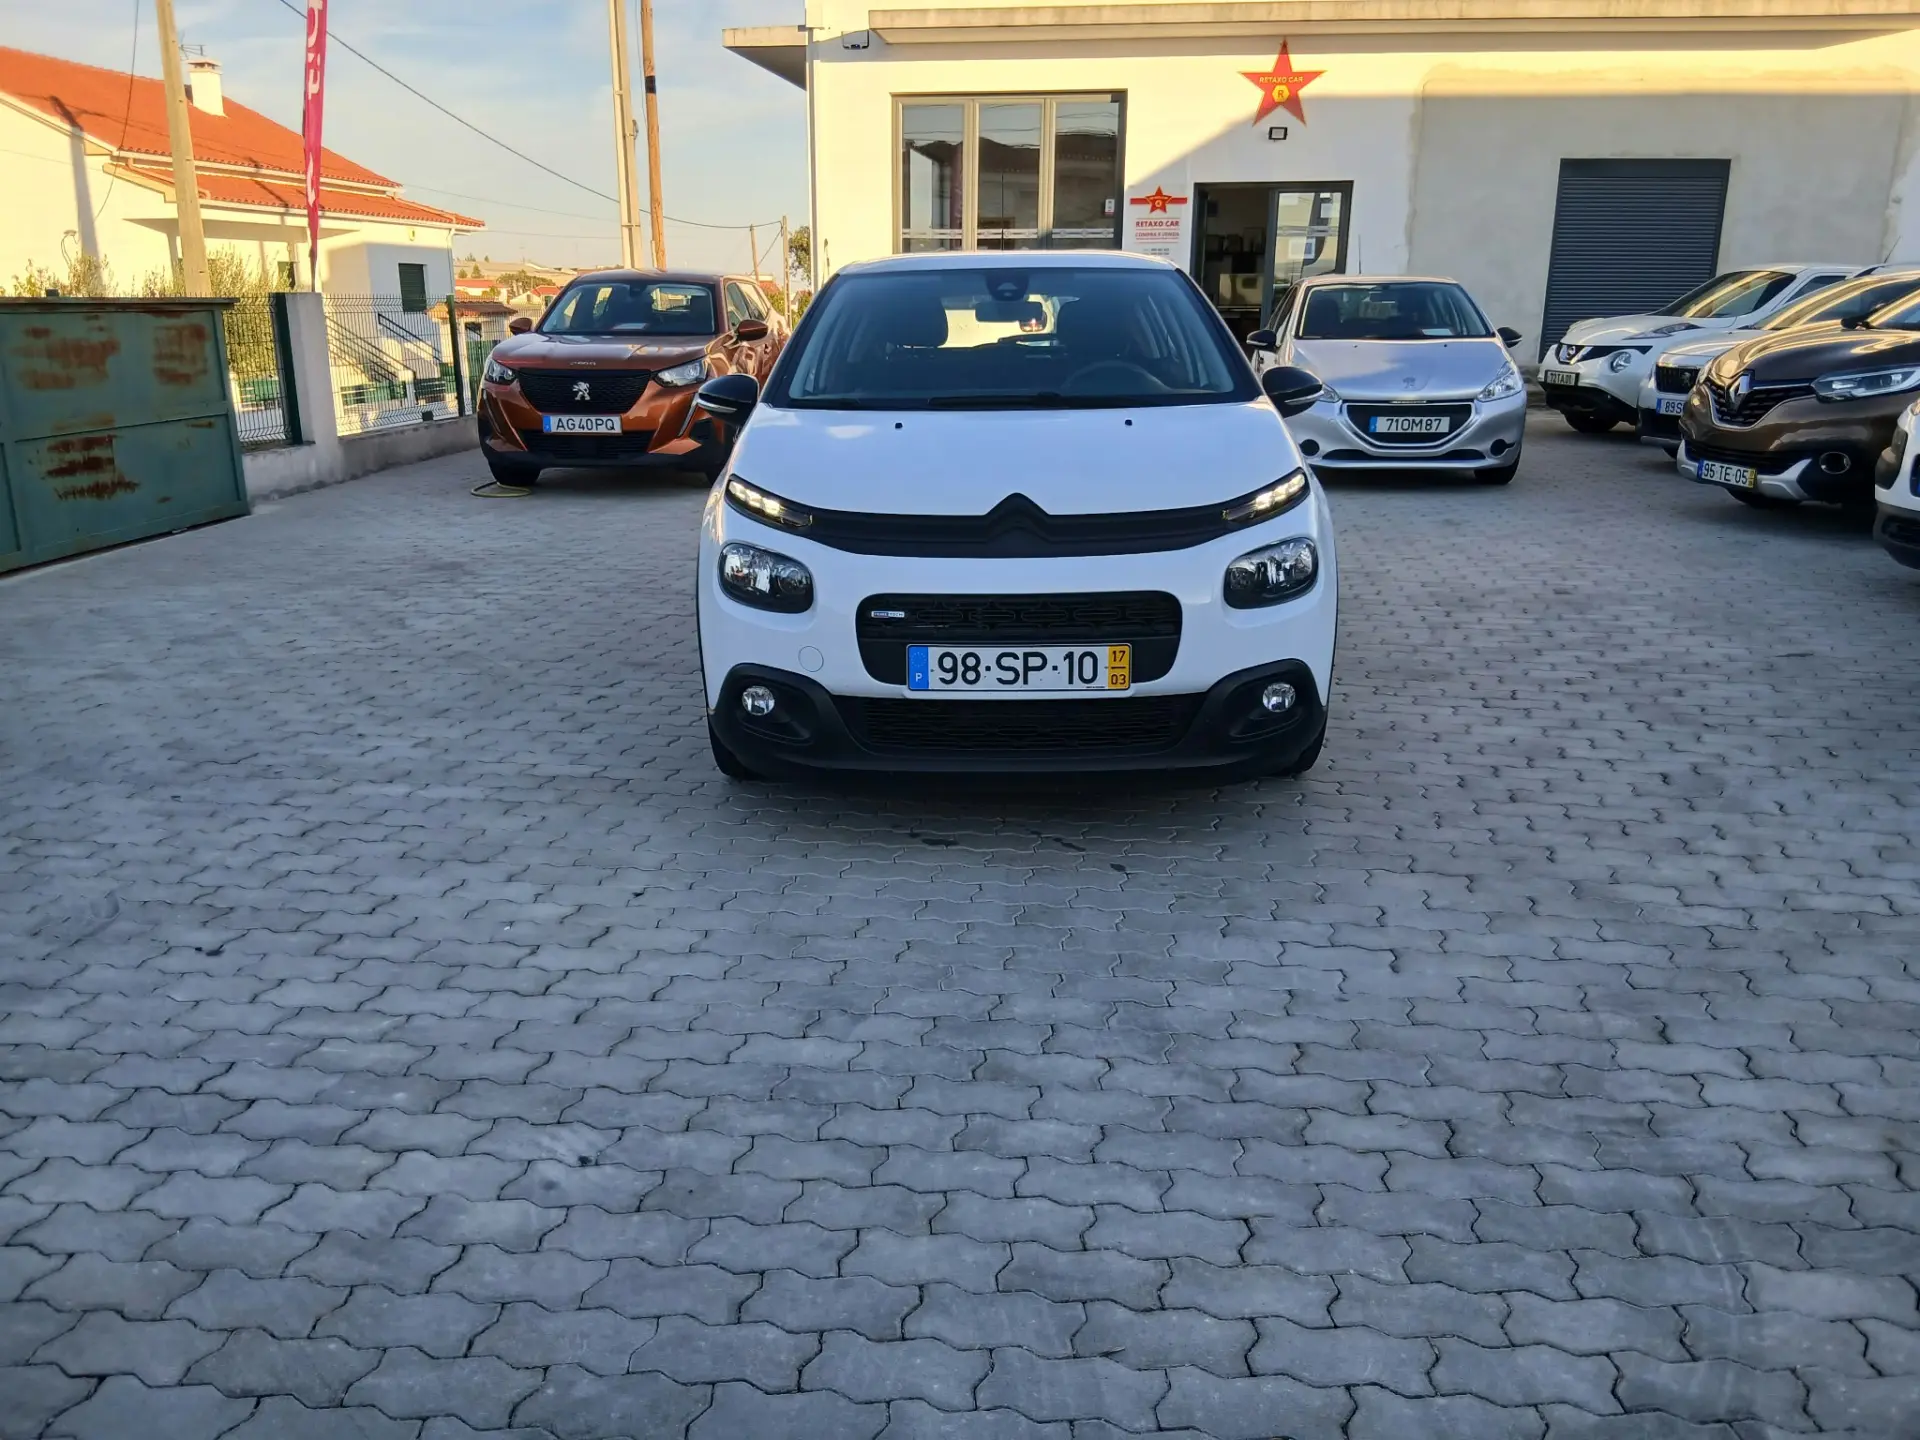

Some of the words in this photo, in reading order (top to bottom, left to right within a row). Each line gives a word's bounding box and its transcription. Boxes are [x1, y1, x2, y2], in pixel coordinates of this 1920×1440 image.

[1277, 90, 1284, 98] R
[1135, 220, 1163, 228] RETAXO
[1664, 400, 1685, 415] 89S
[1112, 650, 1126, 662] 17
[915, 673, 923, 682] P
[1111, 673, 1127, 686] 03
